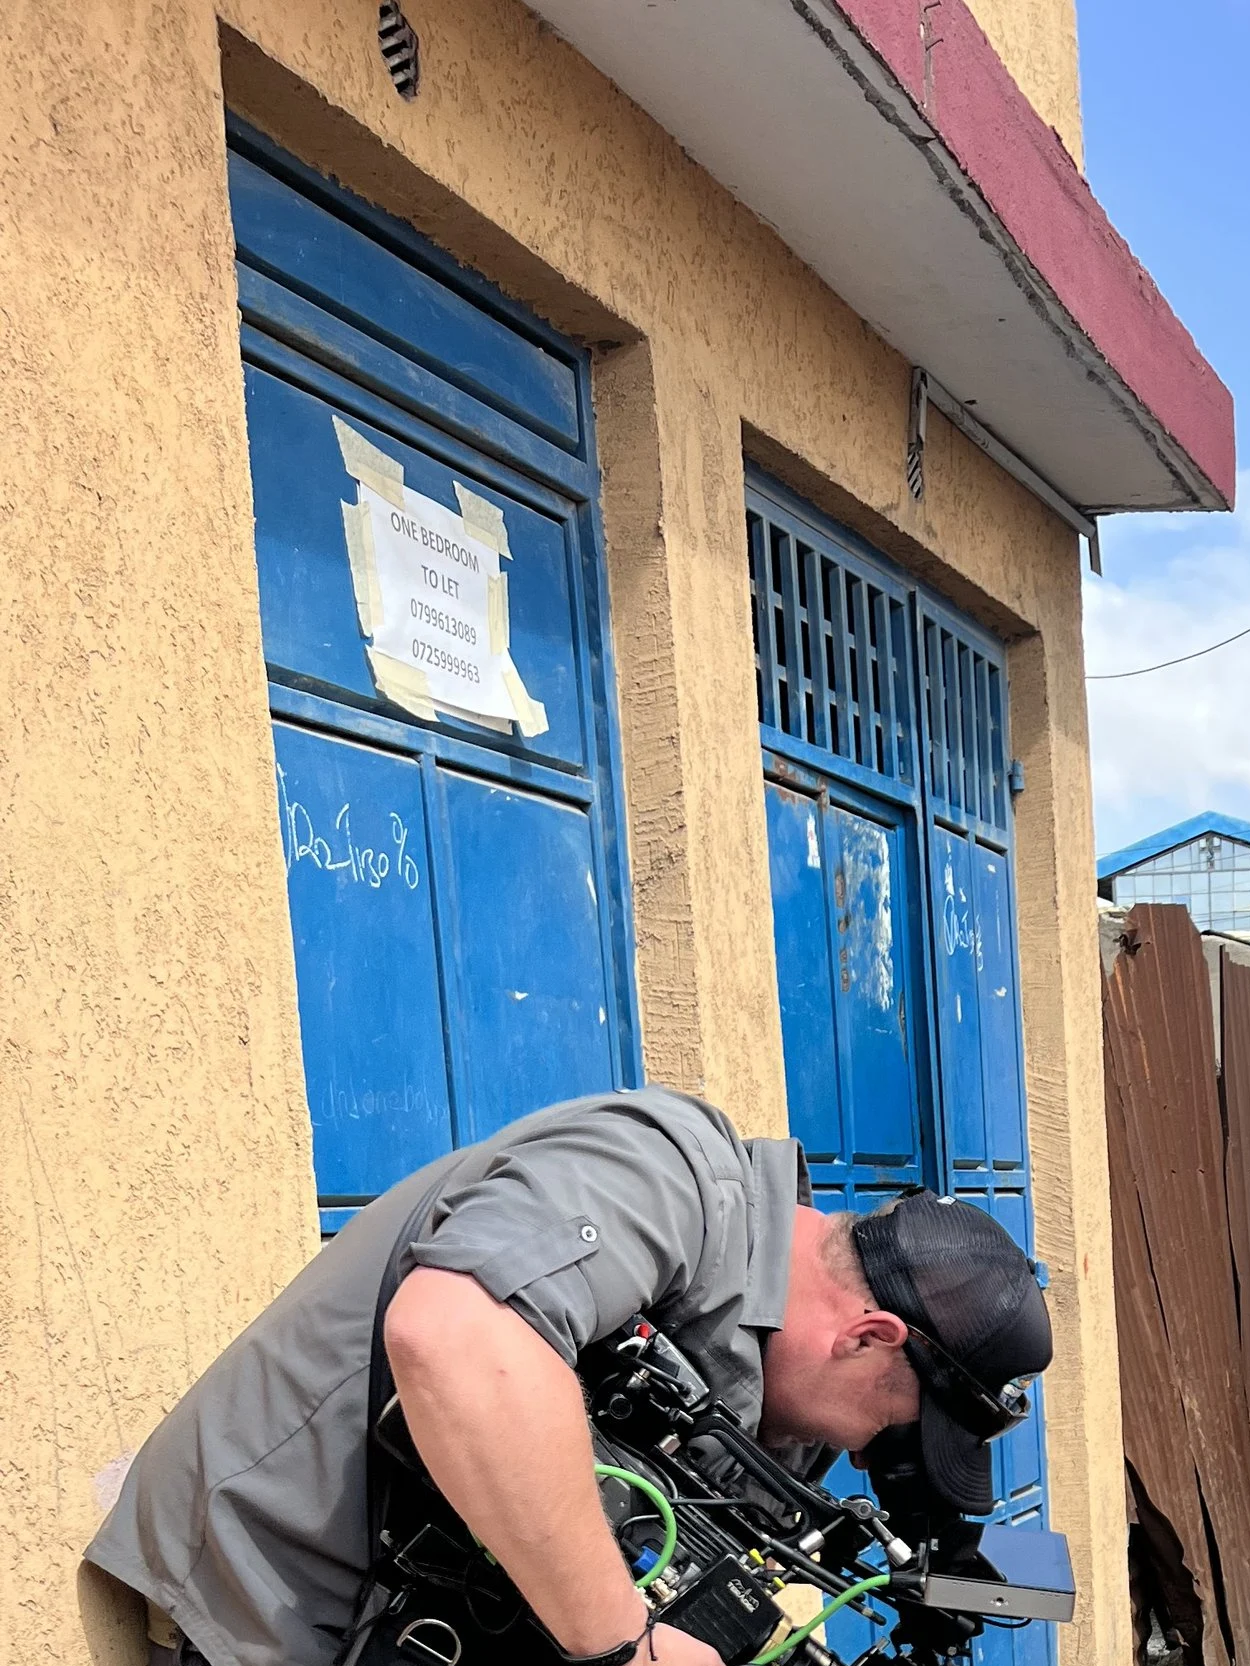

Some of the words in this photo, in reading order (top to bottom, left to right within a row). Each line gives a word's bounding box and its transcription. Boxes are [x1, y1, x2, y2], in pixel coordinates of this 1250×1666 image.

[391, 512, 419, 542] ONE
[421, 526, 480, 573] BEDROOM
[421, 564, 438, 589] TO
[441, 574, 460, 600] LET
[410, 598, 477, 646] 0799613089
[412, 638, 480, 684] 0725999963
